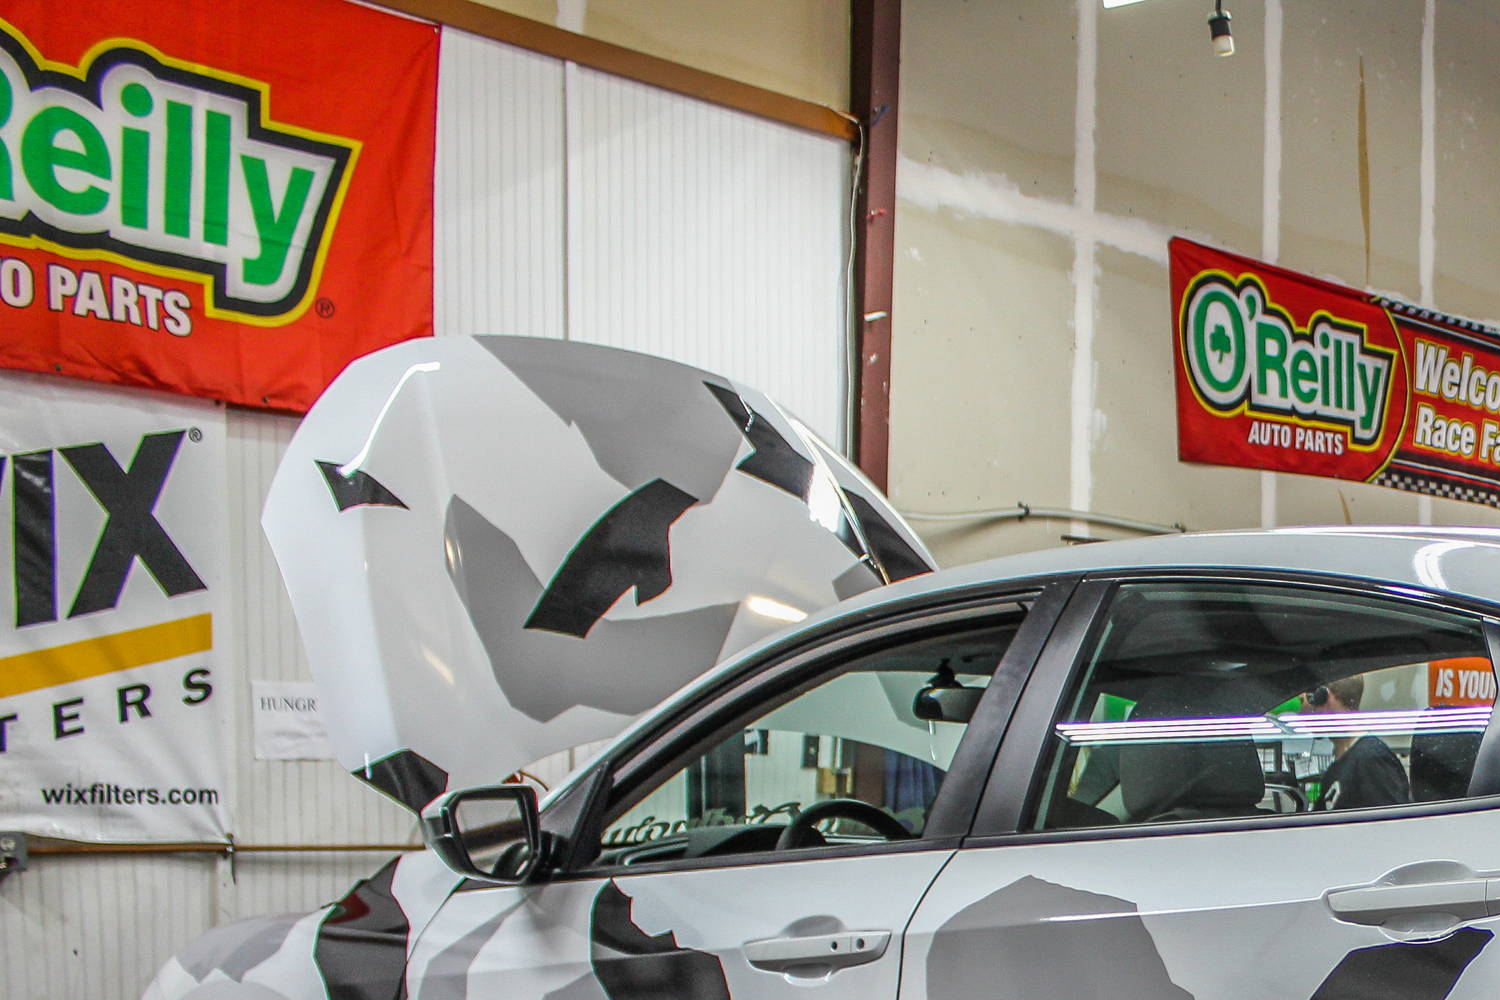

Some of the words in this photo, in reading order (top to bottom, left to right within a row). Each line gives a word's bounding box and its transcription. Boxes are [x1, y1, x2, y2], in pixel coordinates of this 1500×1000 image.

[0, 67, 315, 286] eilly
[48, 263, 192, 337] PARTS
[1193, 290, 1382, 430] O'Reilly
[1248, 421, 1291, 448] AUTO
[1295, 427, 1343, 455] PARTS
[1415, 406, 1475, 455] Race
[0, 430, 207, 627] IX
[1435, 668, 1454, 698] IS
[41, 783, 219, 805] wixfilters.com
